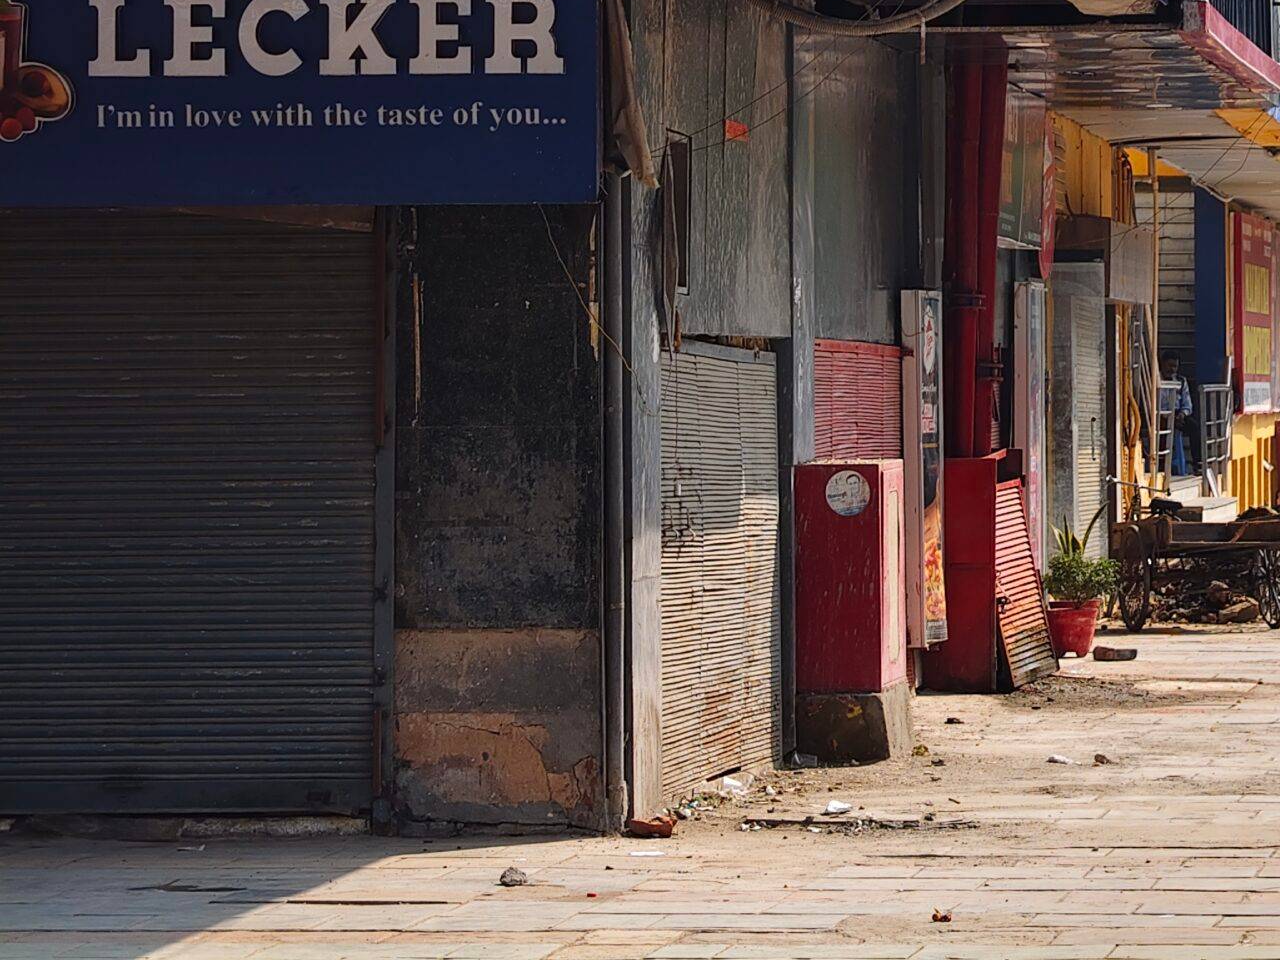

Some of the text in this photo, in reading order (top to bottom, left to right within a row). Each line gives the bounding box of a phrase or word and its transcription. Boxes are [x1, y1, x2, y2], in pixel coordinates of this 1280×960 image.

[149, 103, 175, 128] in
[185, 104, 242, 127] love
[251, 103, 313, 127] with
[324, 103, 368, 126] the
[377, 104, 444, 126] taste
[453, 101, 483, 125] of
[489, 107, 567, 132] you...
